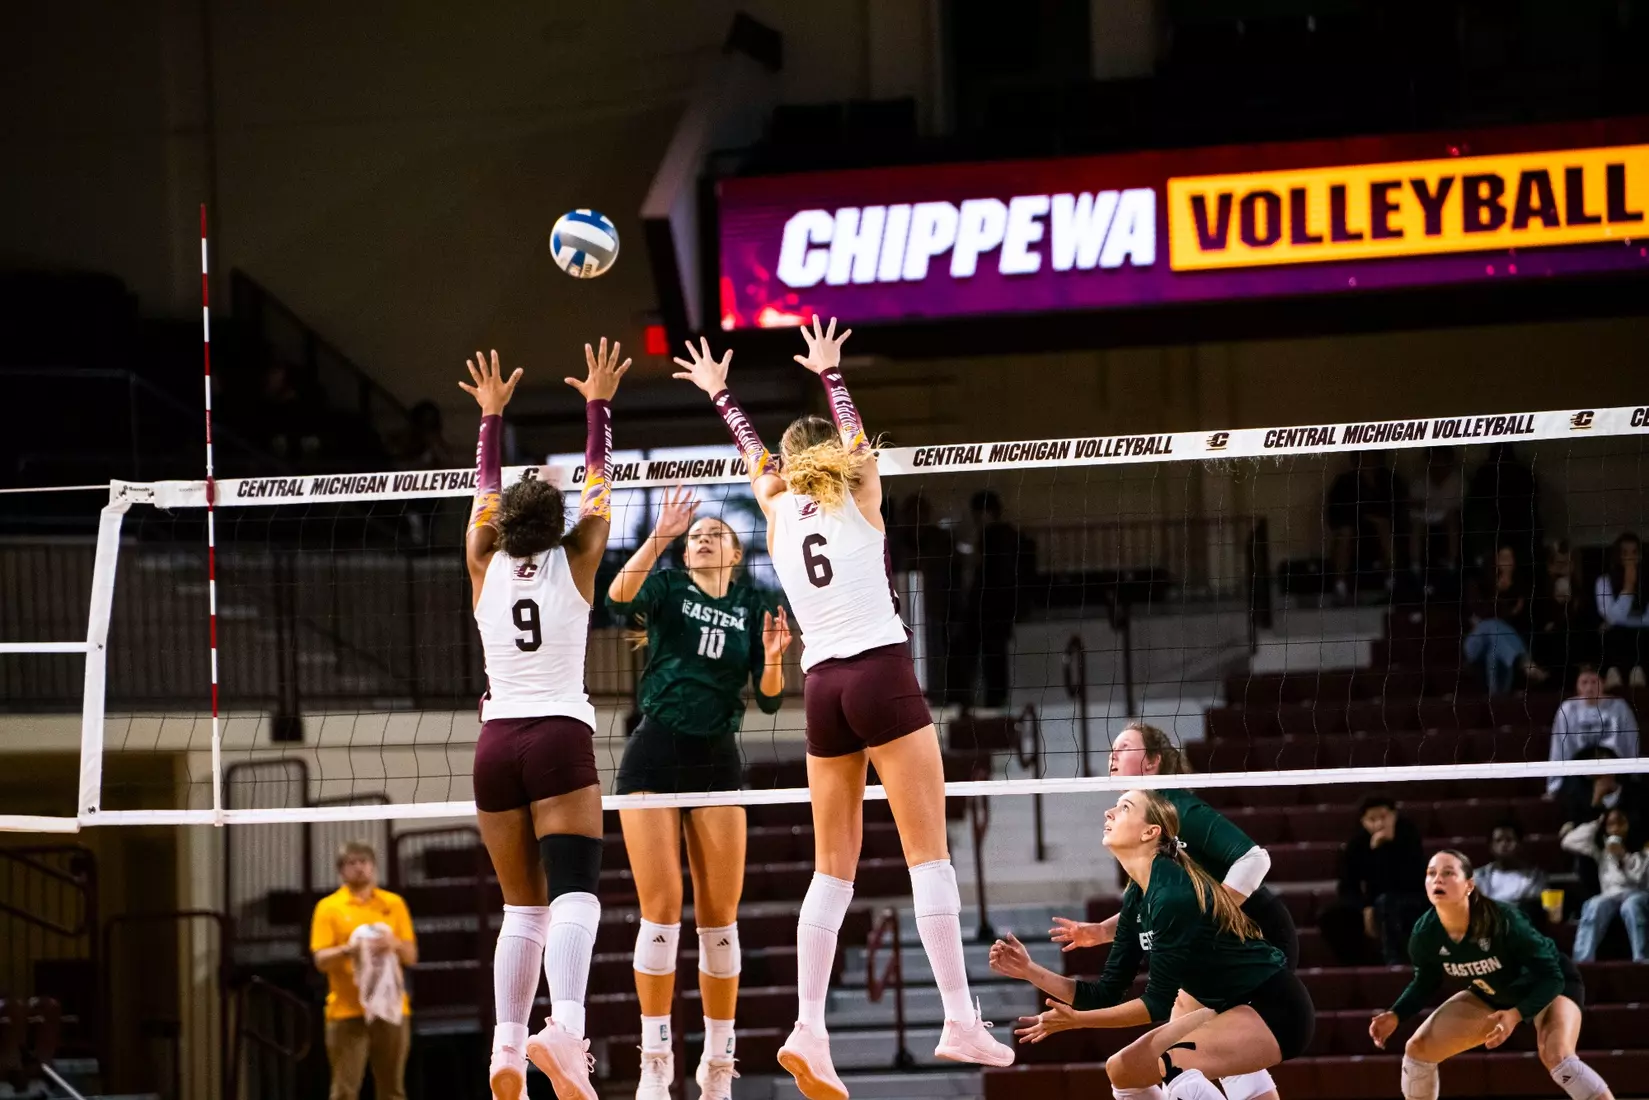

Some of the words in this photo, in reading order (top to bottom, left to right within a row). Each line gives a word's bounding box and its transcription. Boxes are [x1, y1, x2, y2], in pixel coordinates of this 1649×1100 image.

[776, 187, 1156, 288] CHIPPEWA
[1189, 163, 1645, 253] VOLLEYBALL
[1264, 427, 1336, 448] CENTRAL
[1341, 420, 1427, 445] MICHIGAN
[1432, 414, 1535, 440] VOLLEYBALL
[913, 447, 983, 467] CENTRAL
[988, 440, 1069, 463] MICHIGAN
[1074, 435, 1173, 459] VOLLEYBALL
[237, 478, 304, 498] CENTRAL
[309, 475, 389, 496] MICHIGAN
[392, 470, 477, 493] VOLLEYBAL
[572, 462, 641, 484] CRAL
[646, 459, 727, 480] MICHIGAN
[802, 533, 833, 588] 6
[512, 599, 542, 652] 9
[697, 626, 726, 660] 10
[1443, 956, 1502, 977] EASTERN
